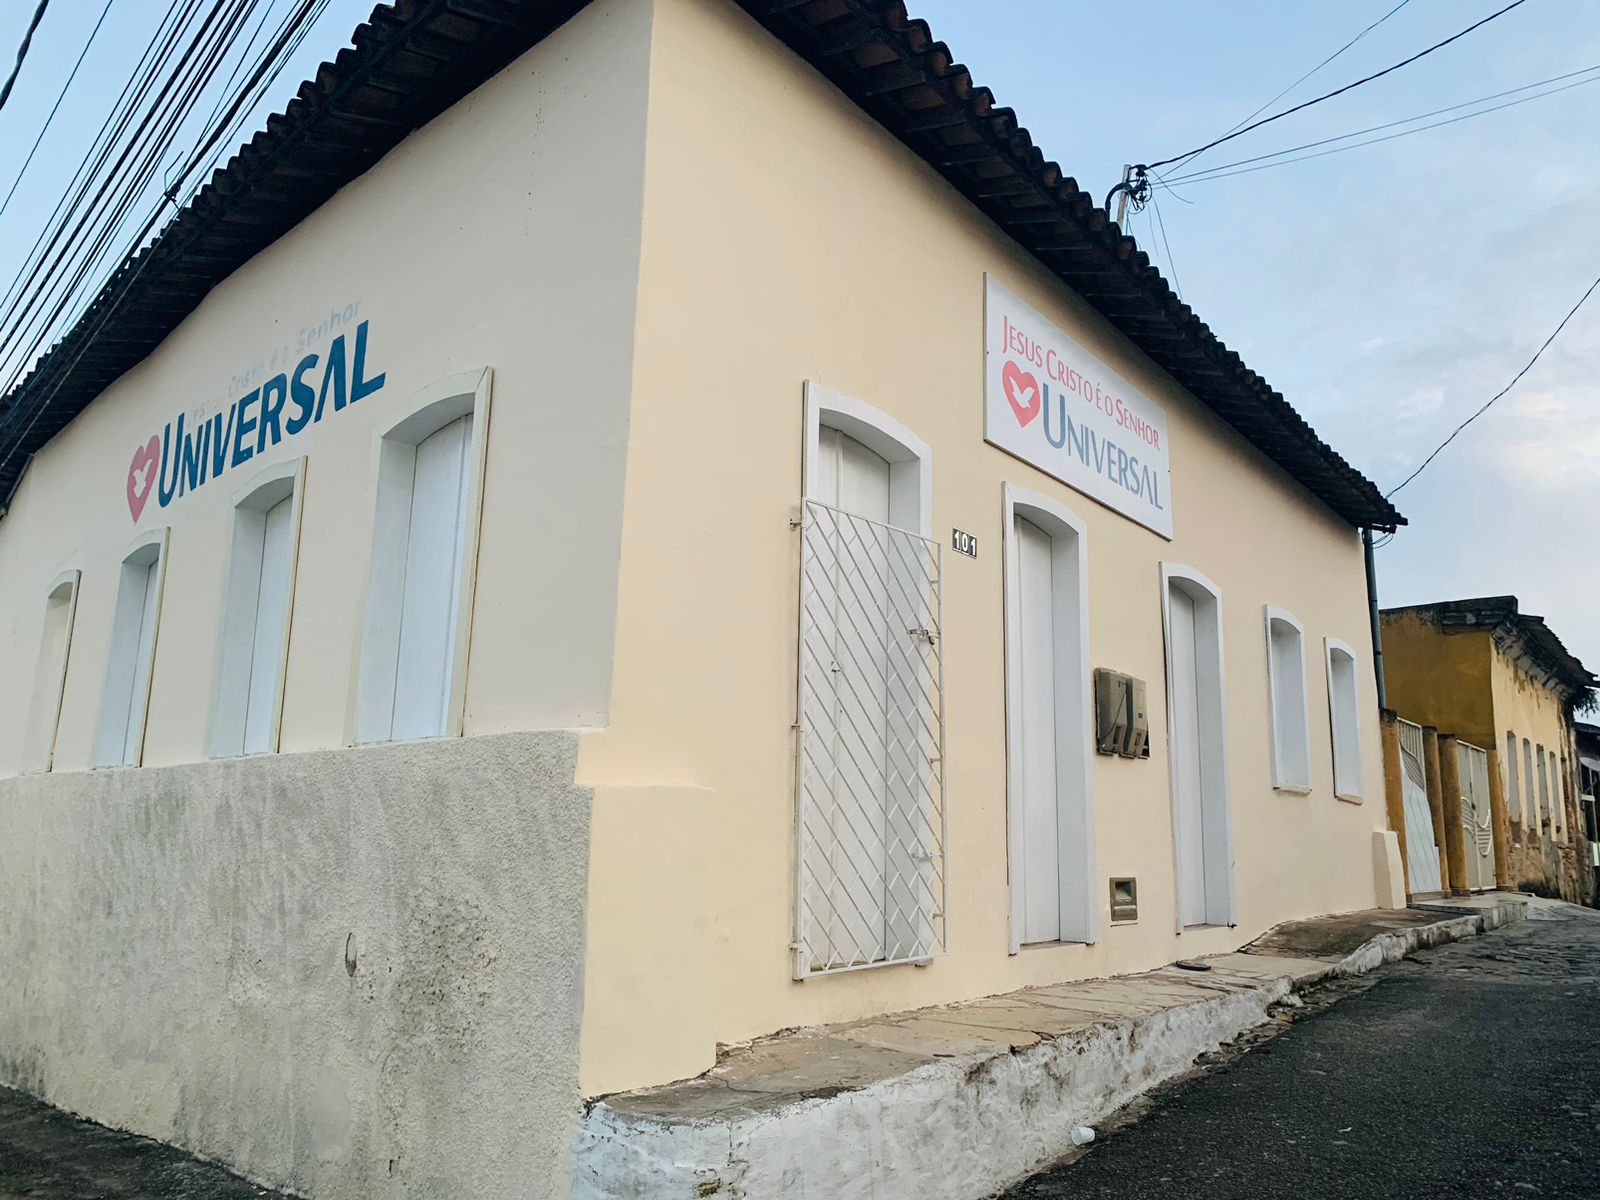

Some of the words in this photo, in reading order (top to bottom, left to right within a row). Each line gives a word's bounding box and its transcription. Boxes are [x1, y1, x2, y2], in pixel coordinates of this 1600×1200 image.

[158, 319, 386, 508] UNIVERSAL
[1002, 314, 1043, 369] JESUS
[1046, 348, 1093, 403] CRISTO
[1095, 381, 1102, 410] É
[1104, 395, 1114, 417] O
[1115, 398, 1161, 452] SENHOR
[1042, 382, 1164, 511] UNIVERSAL
[954, 530, 976, 556] 101
